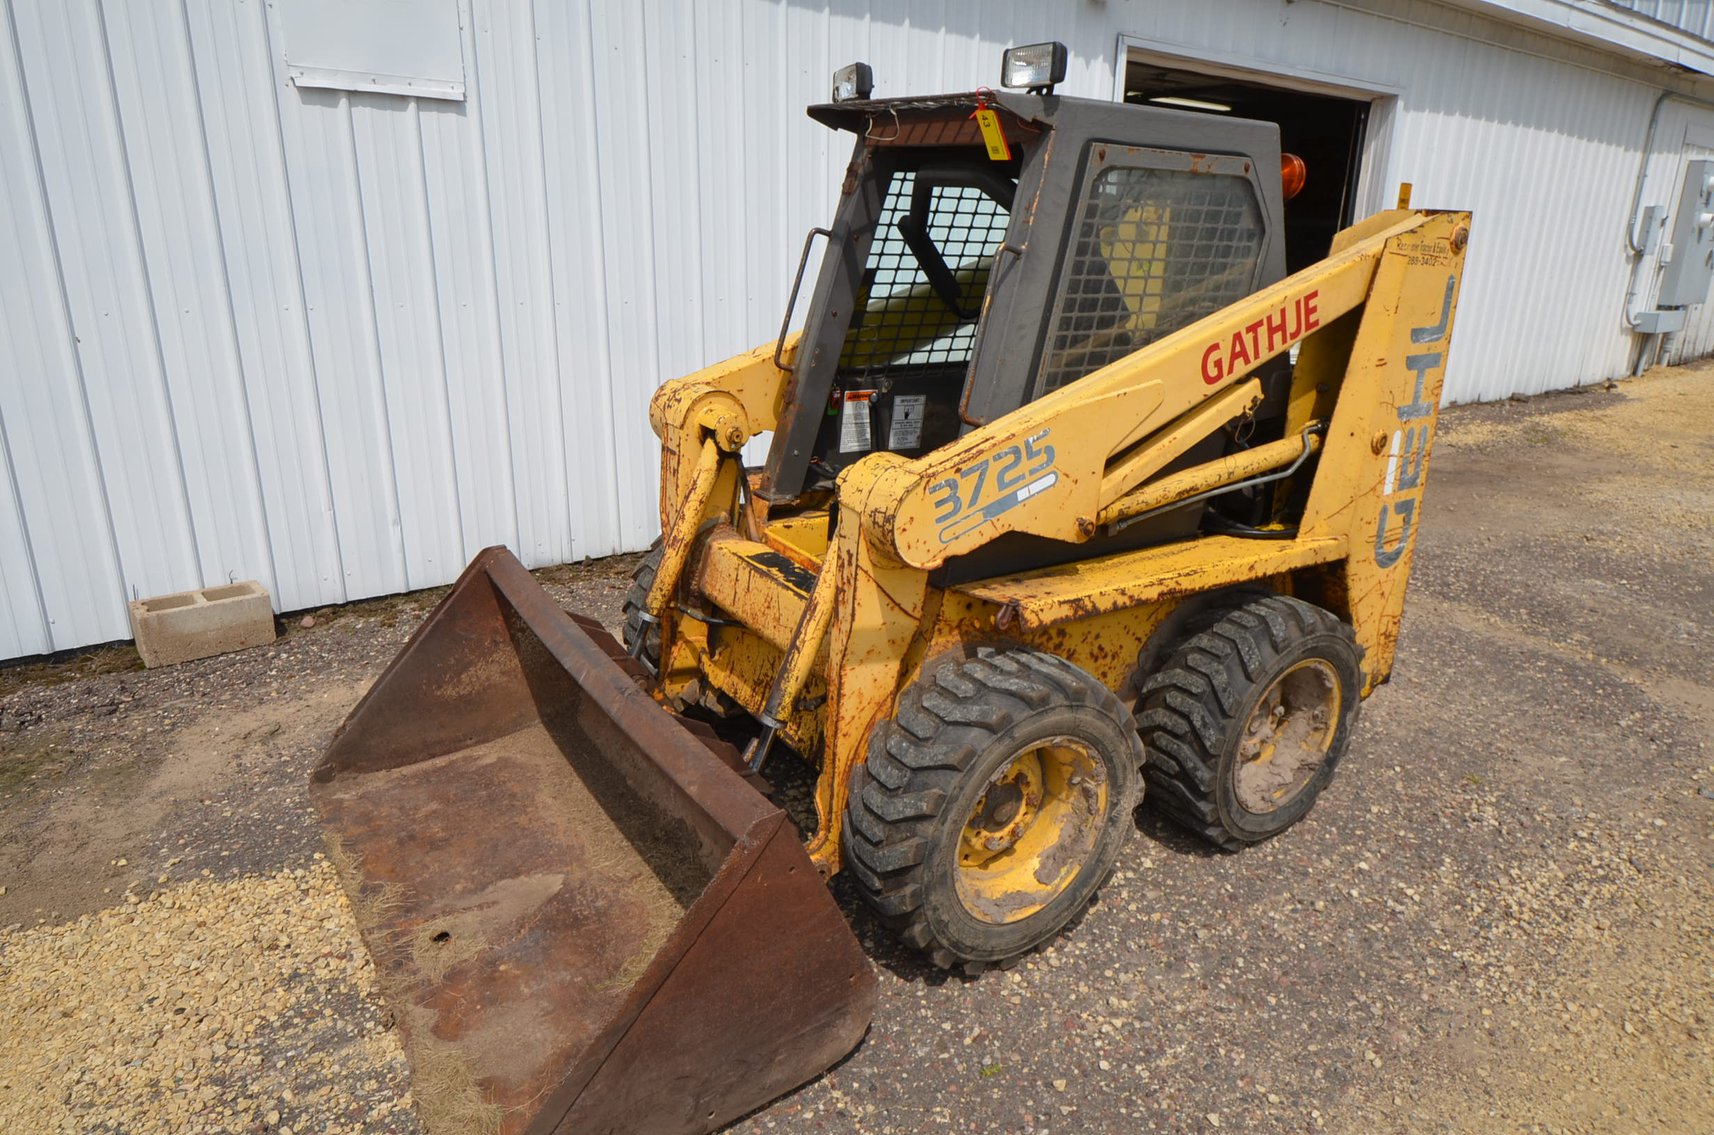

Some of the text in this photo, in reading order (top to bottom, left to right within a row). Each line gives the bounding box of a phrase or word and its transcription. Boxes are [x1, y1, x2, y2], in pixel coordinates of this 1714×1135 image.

[1201, 289, 1320, 385] GATHJE
[1374, 274, 1456, 569] GEHL
[928, 427, 1056, 525] 3725
